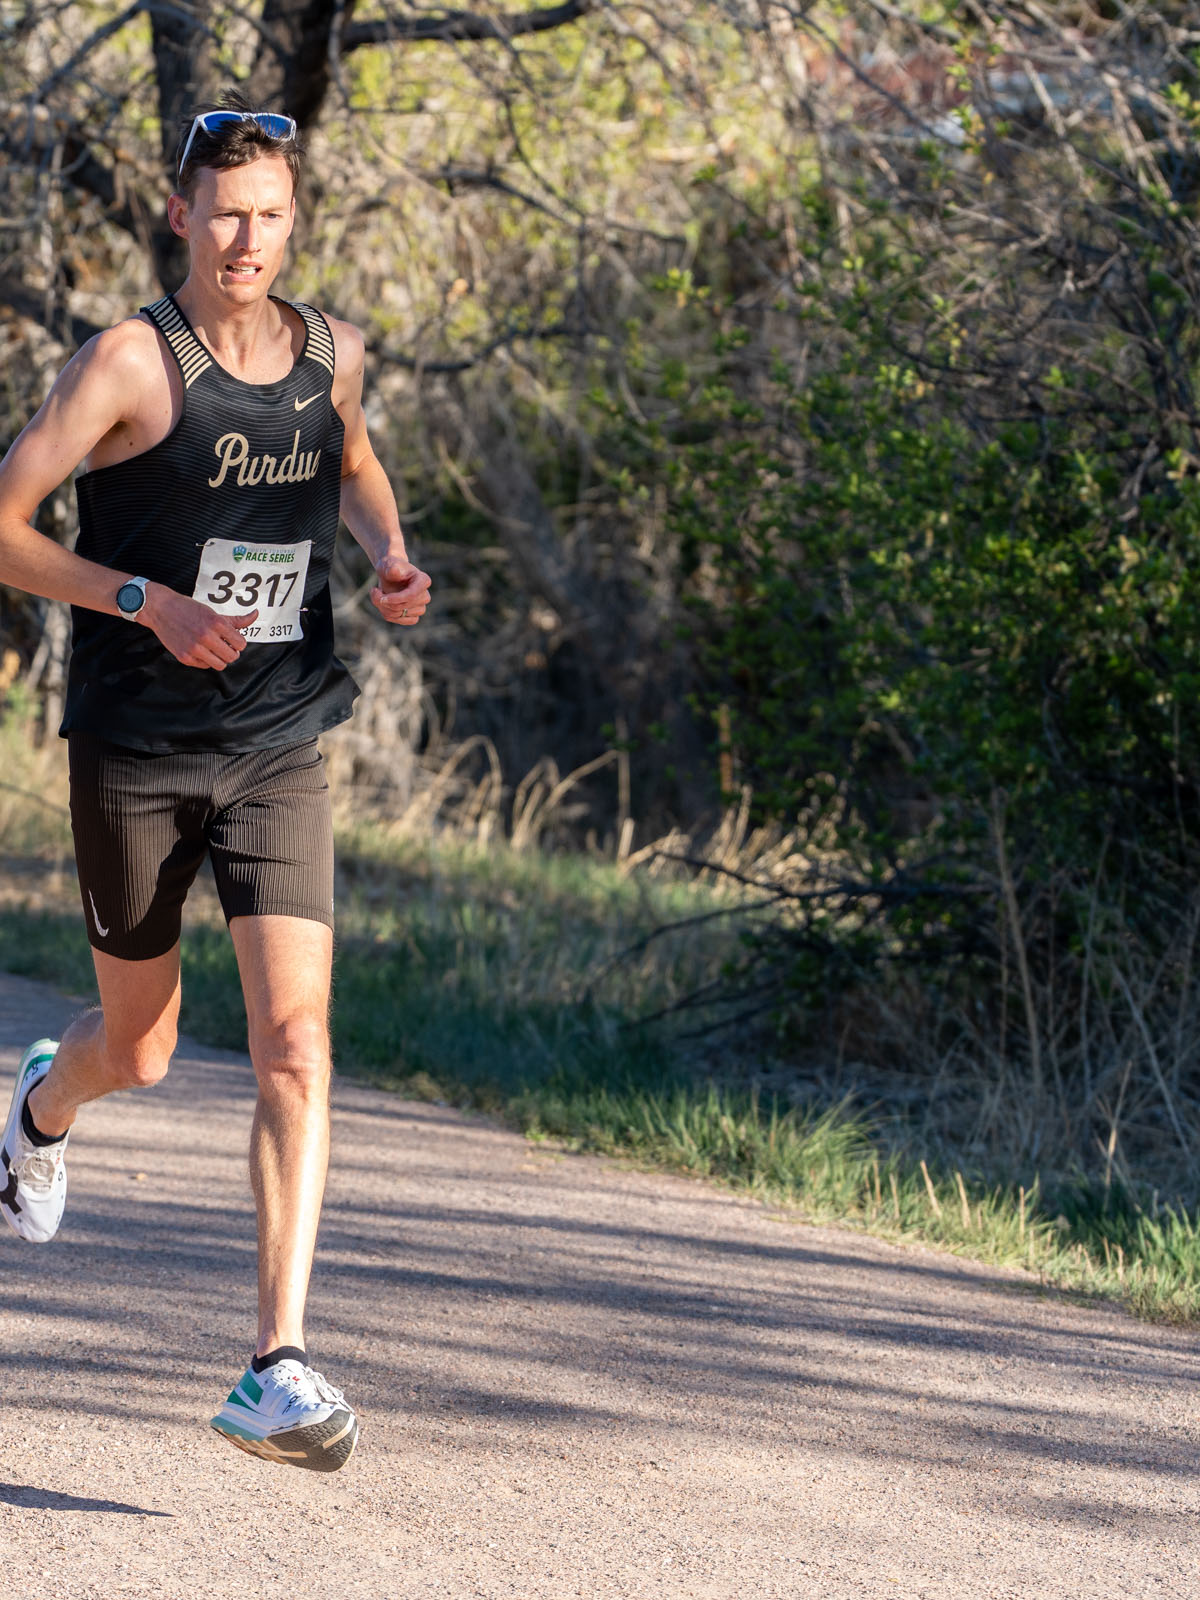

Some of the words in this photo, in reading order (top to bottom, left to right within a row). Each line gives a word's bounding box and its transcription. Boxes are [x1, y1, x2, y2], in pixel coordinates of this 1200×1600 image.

[245, 551, 269, 562] RACE
[269, 552, 296, 563] SERIES
[207, 570, 299, 607] 3317
[240, 626, 262, 637] 317
[269, 624, 293, 637] 3317
